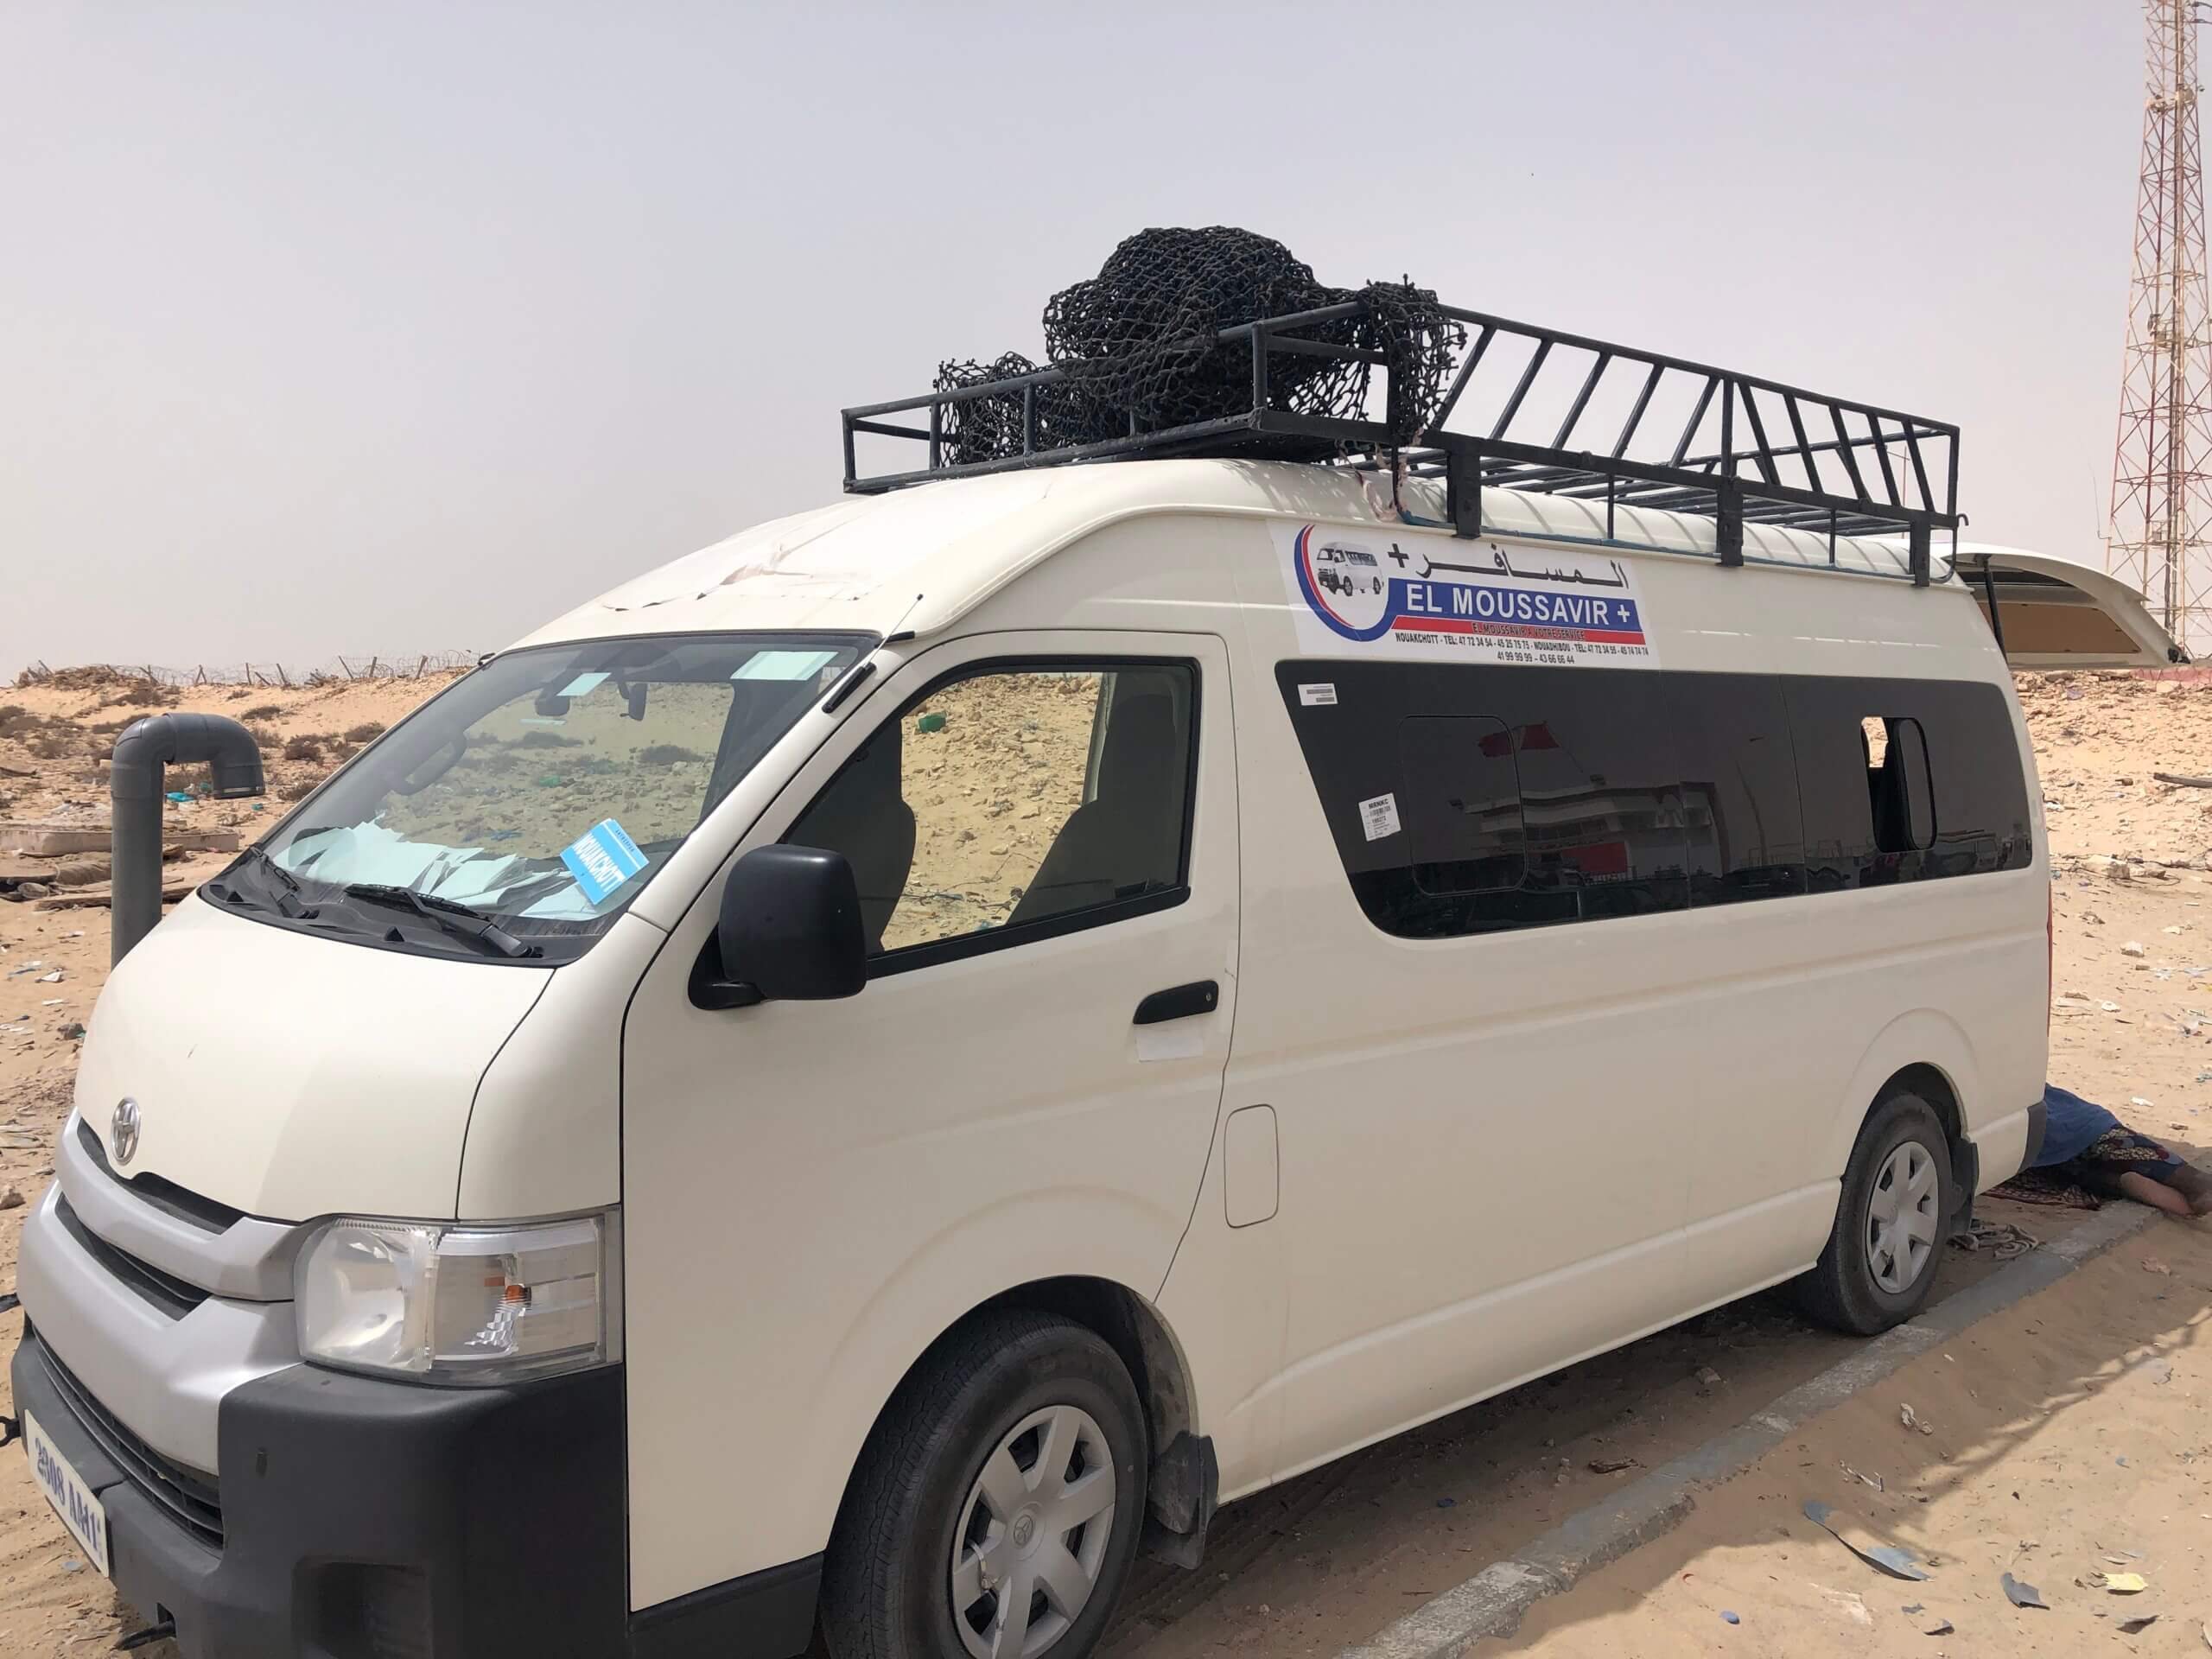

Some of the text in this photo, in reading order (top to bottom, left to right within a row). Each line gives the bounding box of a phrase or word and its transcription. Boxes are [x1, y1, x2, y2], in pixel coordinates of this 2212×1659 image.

[1407, 583, 1443, 613] EL
[1452, 587, 1610, 625] MOUSSAVIR
[1395, 632, 1439, 645] NOUAKCHOTT
[1505, 652, 1515, 662] 99
[1515, 652, 1523, 662] 99
[572, 833, 626, 893] NOUAKCHOTT
